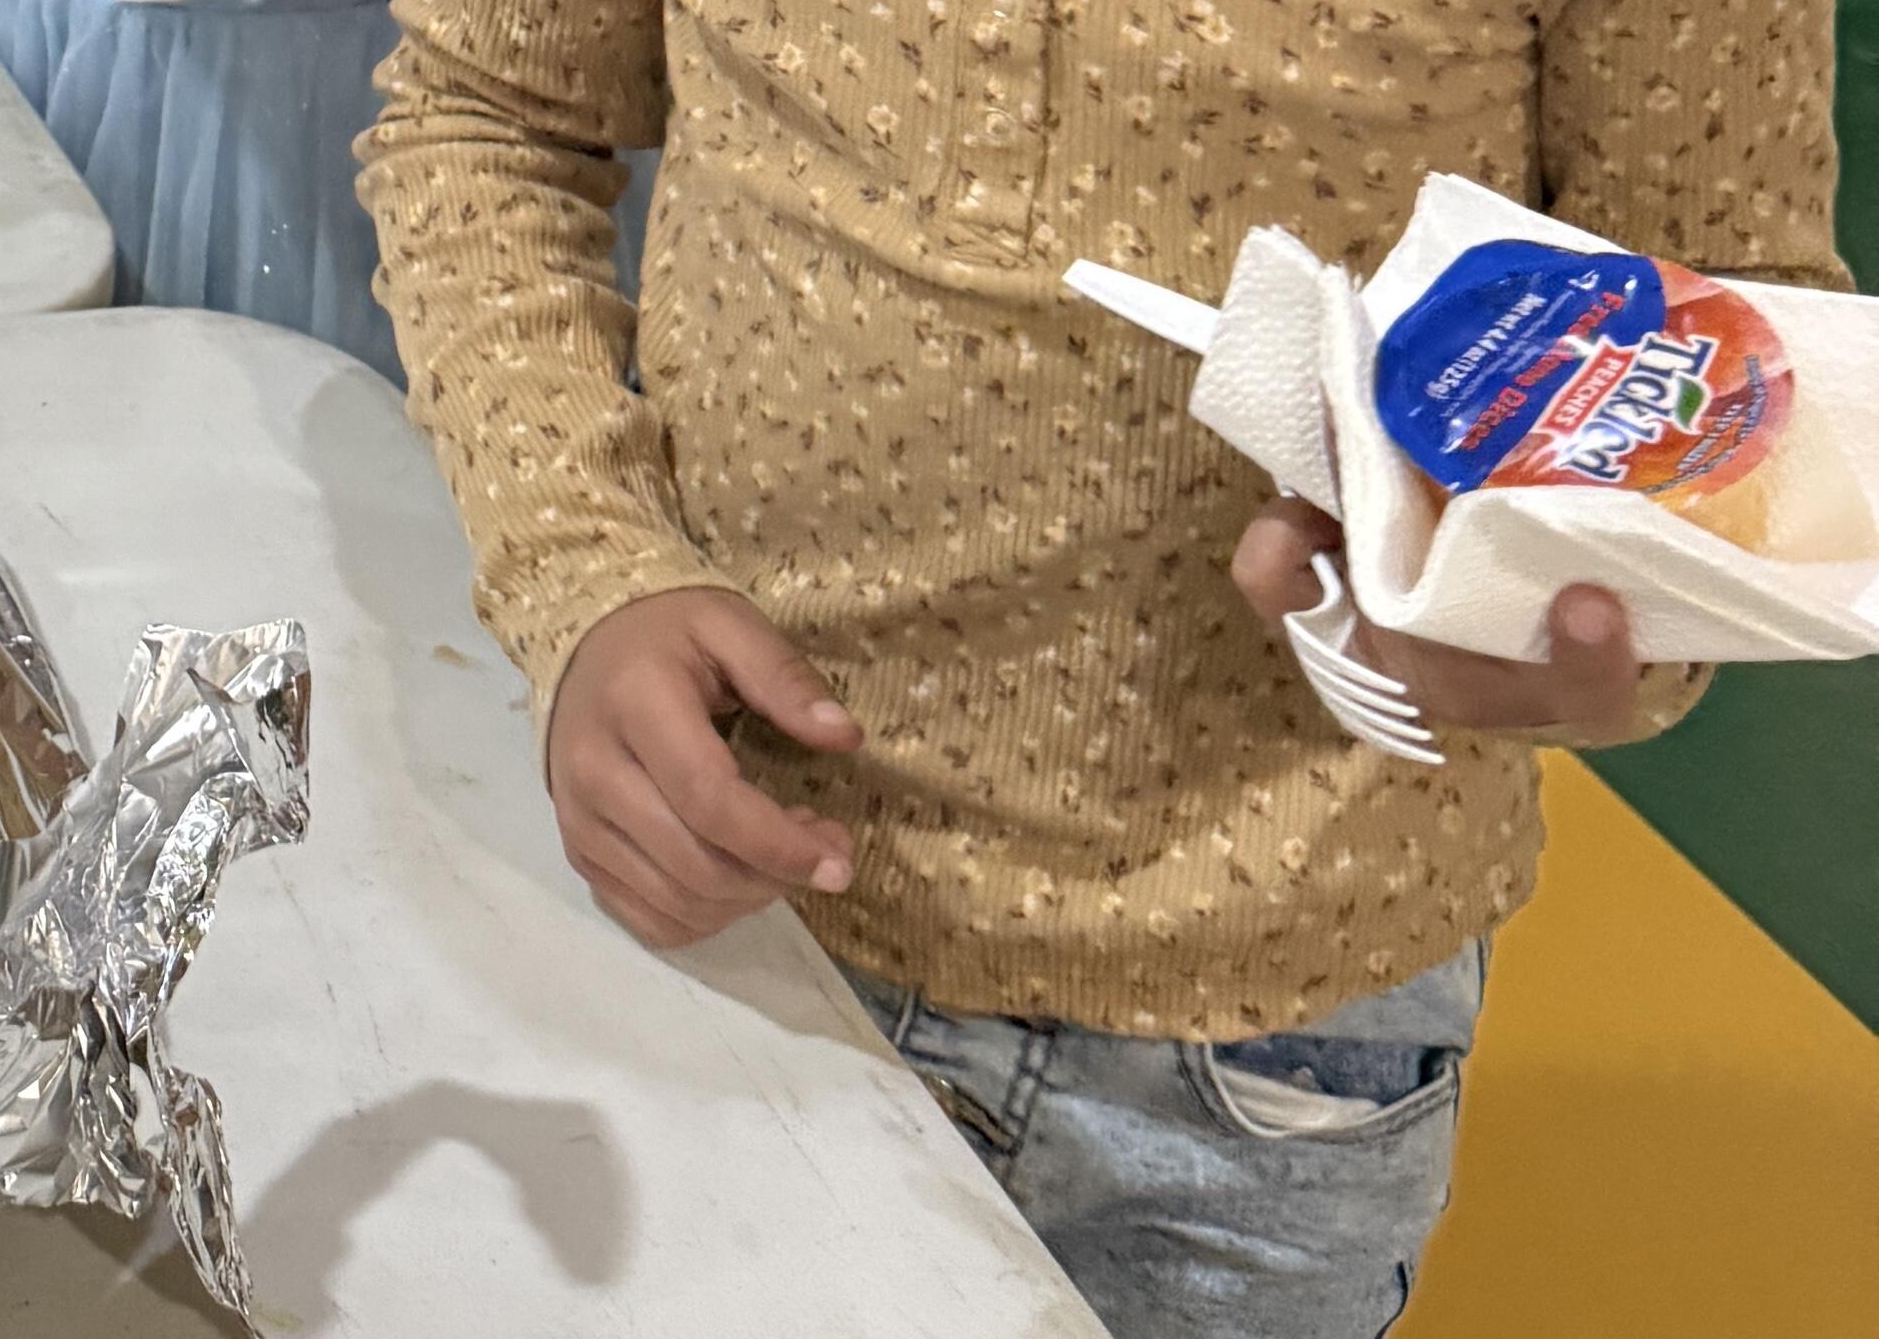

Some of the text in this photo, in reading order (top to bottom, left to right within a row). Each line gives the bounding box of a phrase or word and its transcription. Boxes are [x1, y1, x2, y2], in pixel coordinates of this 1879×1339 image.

[1512, 293, 1625, 387] Freetone
[1552, 358, 1625, 426] PEACHES
[1564, 339, 1709, 476] Tickled
